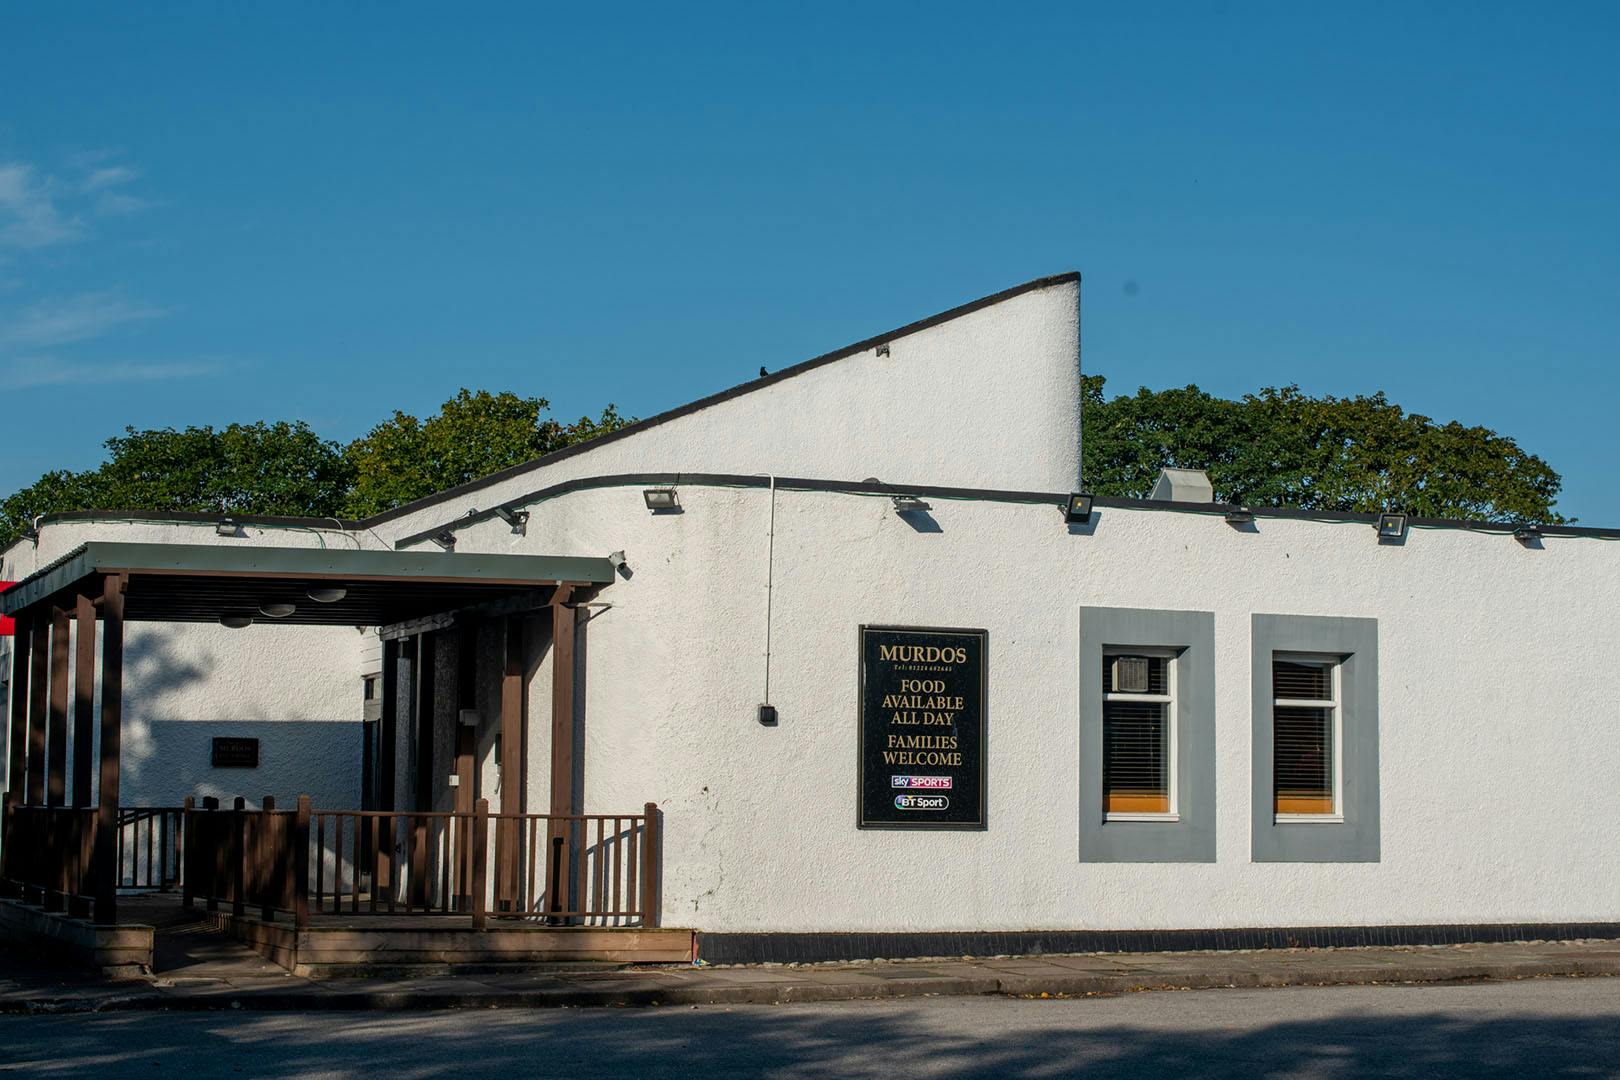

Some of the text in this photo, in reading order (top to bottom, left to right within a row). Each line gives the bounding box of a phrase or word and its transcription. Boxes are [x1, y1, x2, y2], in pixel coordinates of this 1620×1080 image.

[901, 679, 945, 693] FOOD
[882, 695, 964, 710] AVAILABLE
[891, 711, 954, 726] ALL DAY
[888, 735, 958, 750] FAMILIES
[883, 751, 963, 766] WELCOME
[894, 776, 950, 787] sky SPORTS
[901, 798, 943, 808] BT Sport
